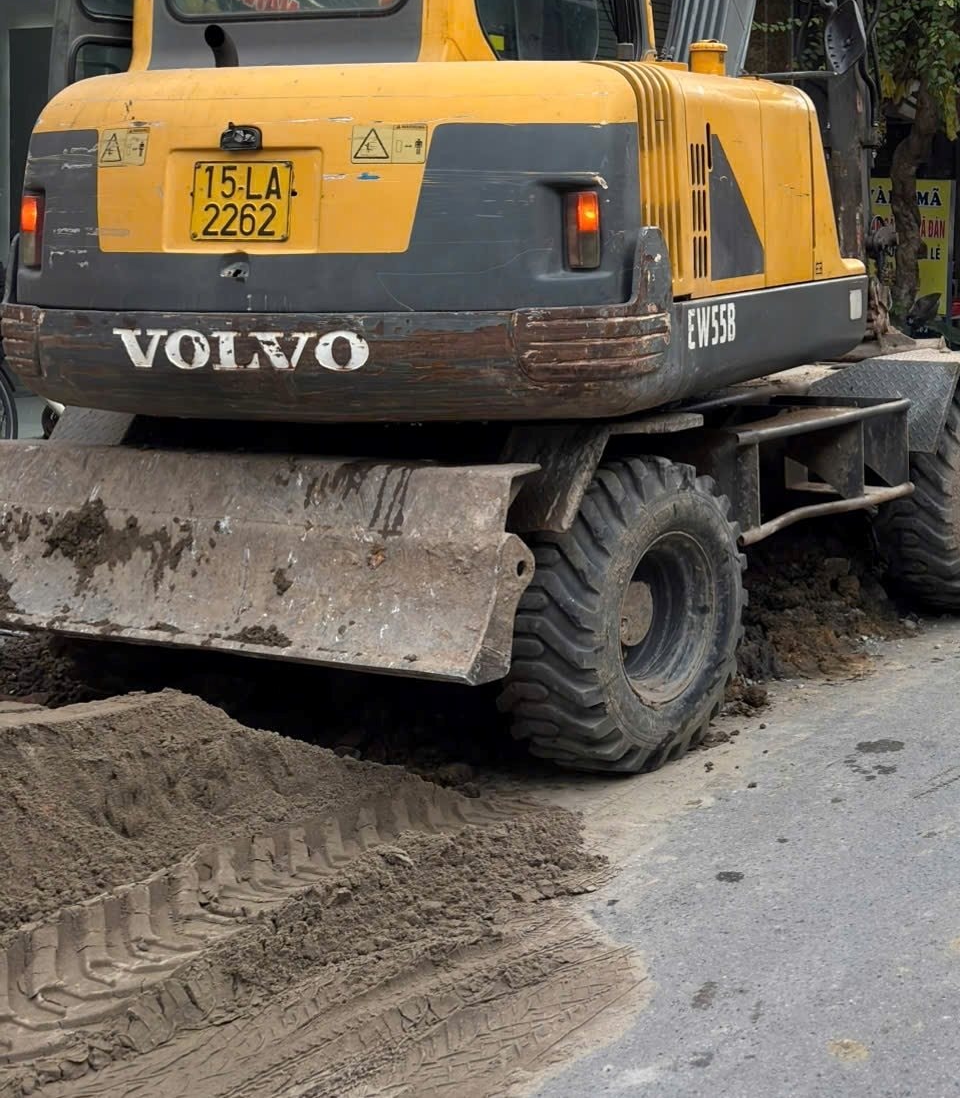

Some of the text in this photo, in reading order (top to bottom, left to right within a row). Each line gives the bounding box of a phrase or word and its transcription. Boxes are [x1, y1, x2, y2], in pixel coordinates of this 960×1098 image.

[204, 165, 282, 200] 15-LA
[917, 188, 942, 206] MÃ
[202, 202, 277, 236] 2262
[688, 302, 736, 350] EW55B
[113, 328, 370, 371] VOLVO
